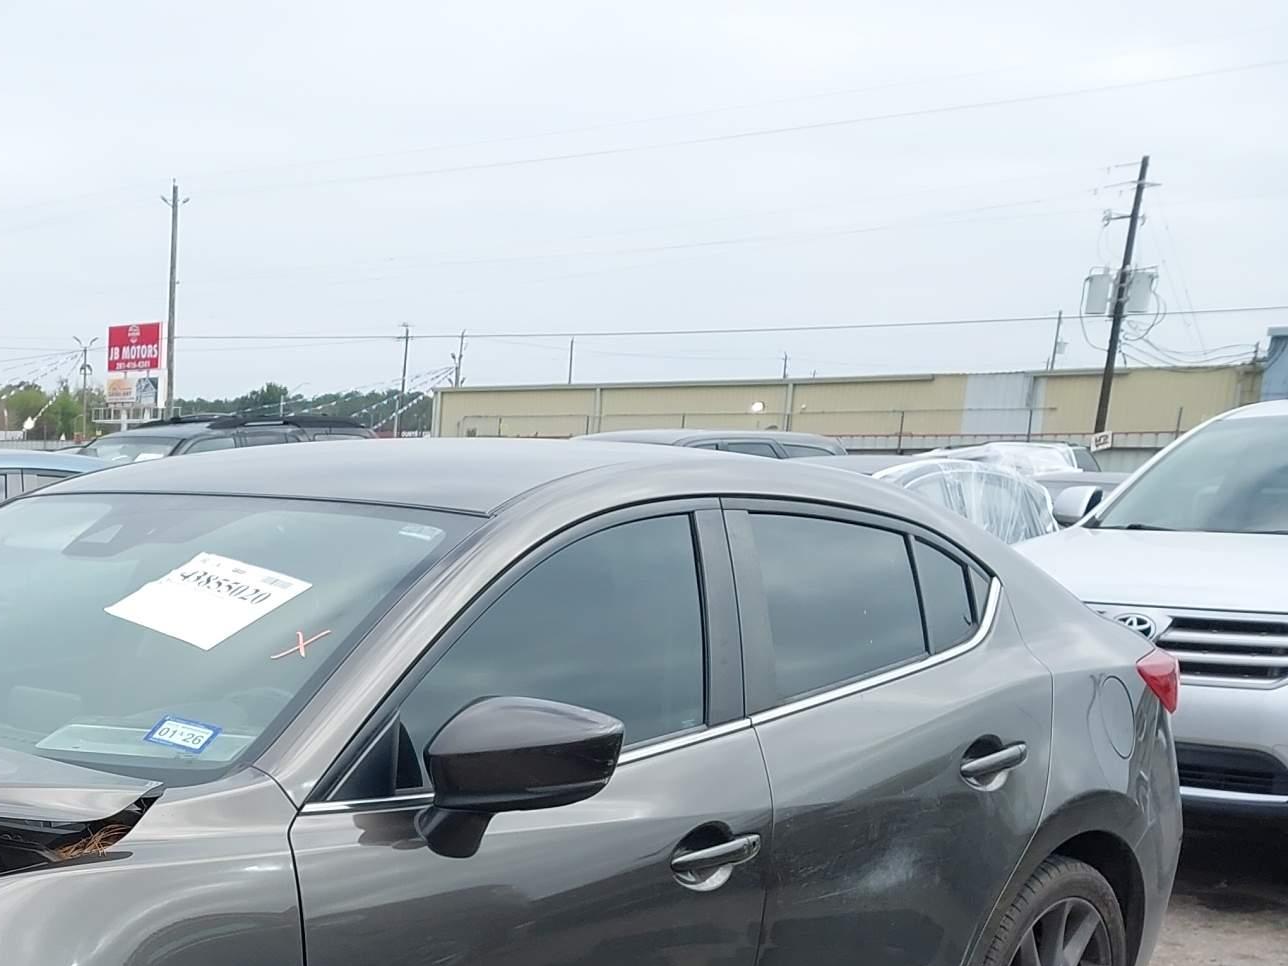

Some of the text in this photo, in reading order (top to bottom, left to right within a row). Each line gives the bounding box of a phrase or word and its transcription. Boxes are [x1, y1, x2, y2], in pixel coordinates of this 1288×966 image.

[110, 343, 158, 361] JB MOTORS
[179, 570, 272, 604] 43855020
